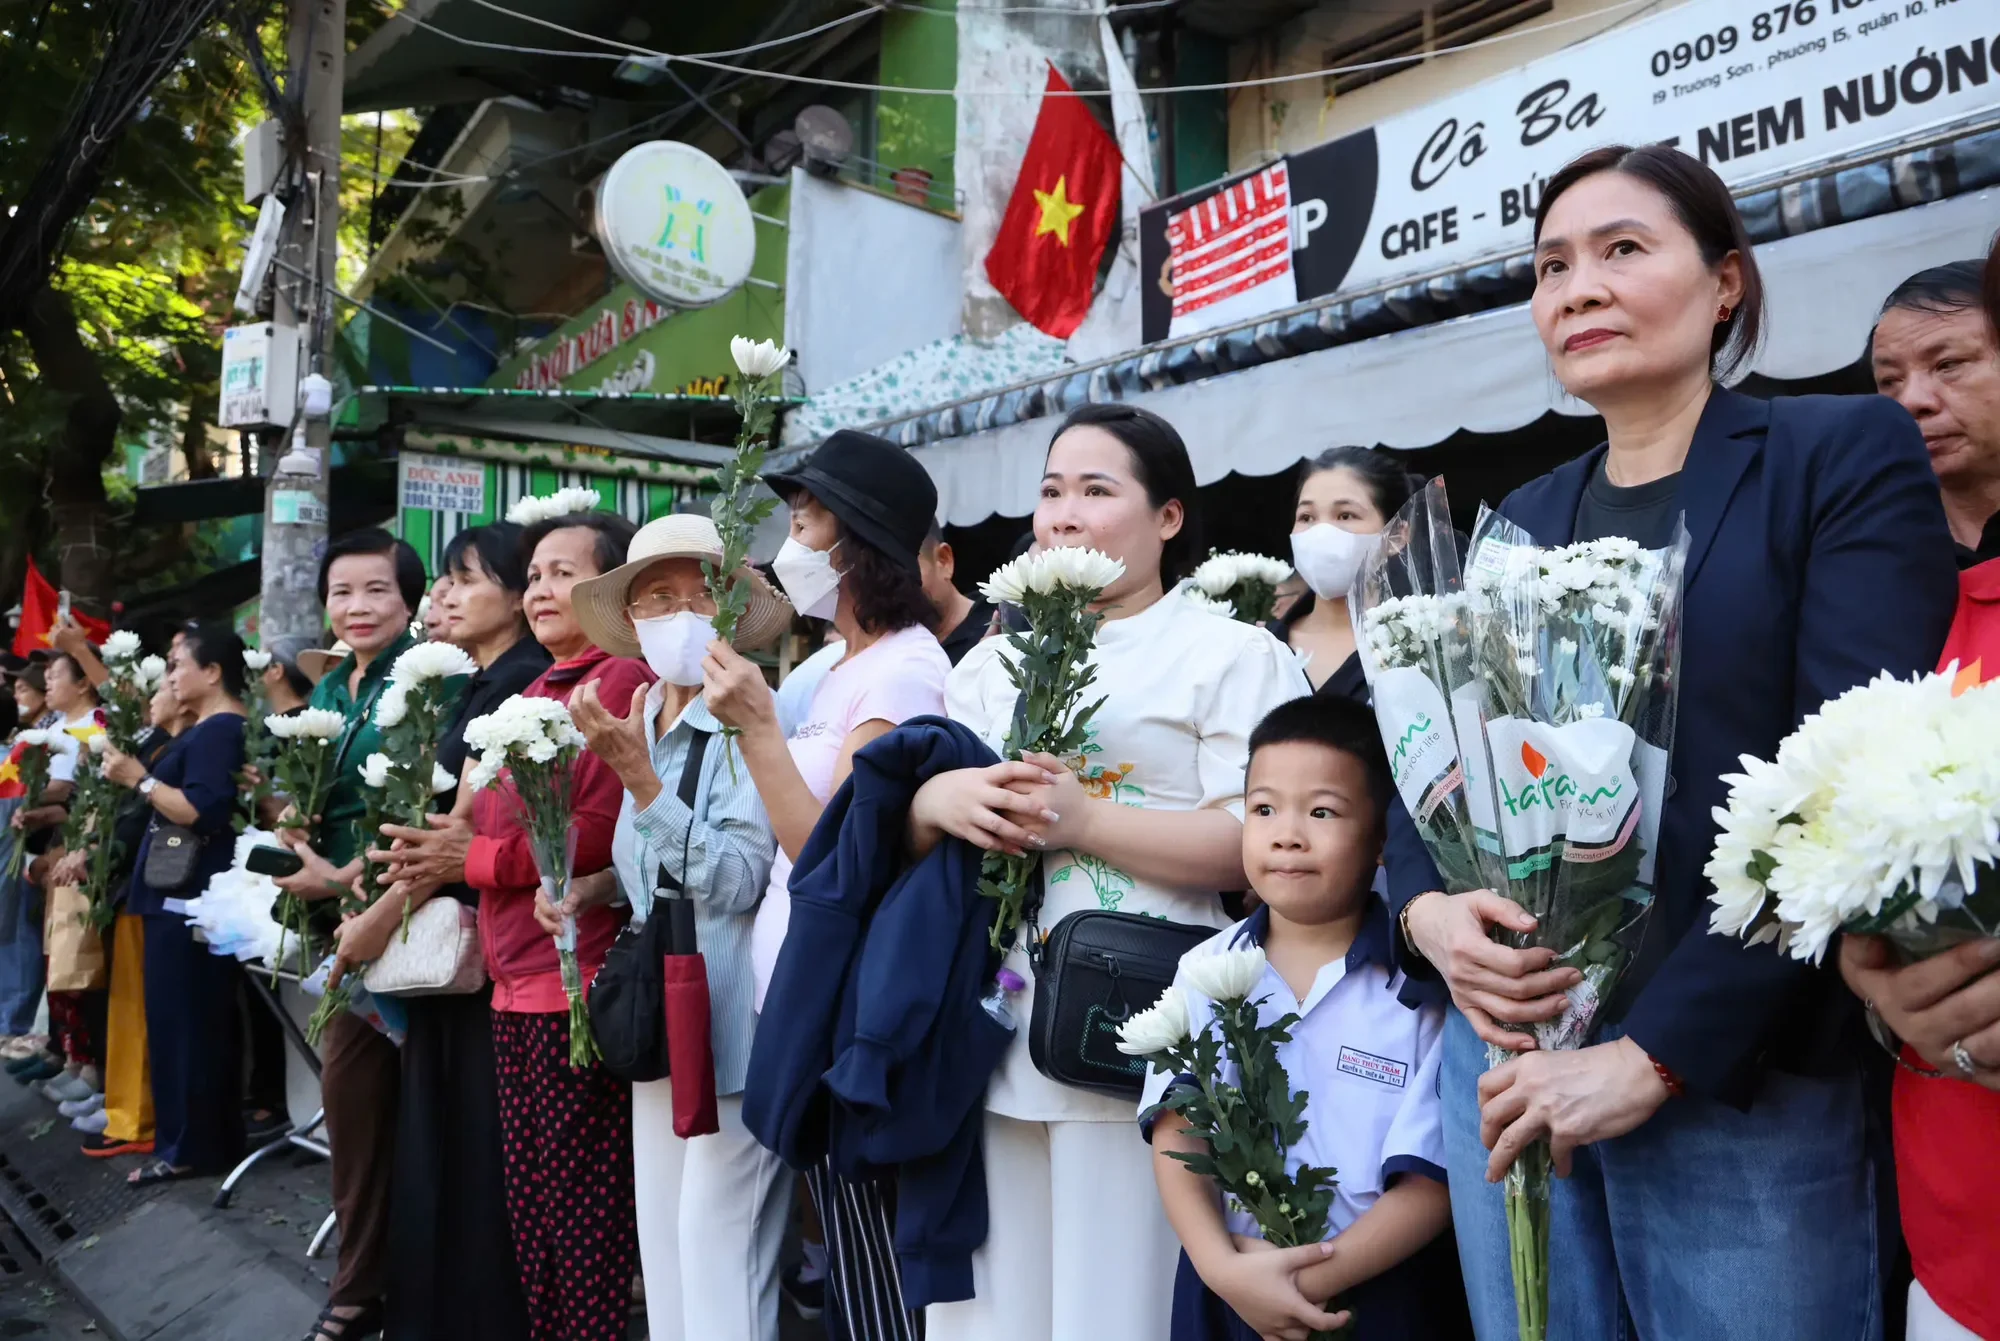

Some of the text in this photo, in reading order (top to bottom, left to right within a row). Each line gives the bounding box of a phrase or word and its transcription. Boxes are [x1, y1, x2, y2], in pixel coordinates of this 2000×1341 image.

[1651, 0, 1817, 77] 0909 876
[1381, 205, 1459, 260] CAFE
[1697, 96, 1805, 165] NEM
[1823, 33, 2000, 131] NƯỚN
[1411, 79, 1606, 192] Cô Ba
[444, 471, 481, 487] ANH
[1408, 746, 1426, 771] your
[1425, 732, 1441, 751] life
